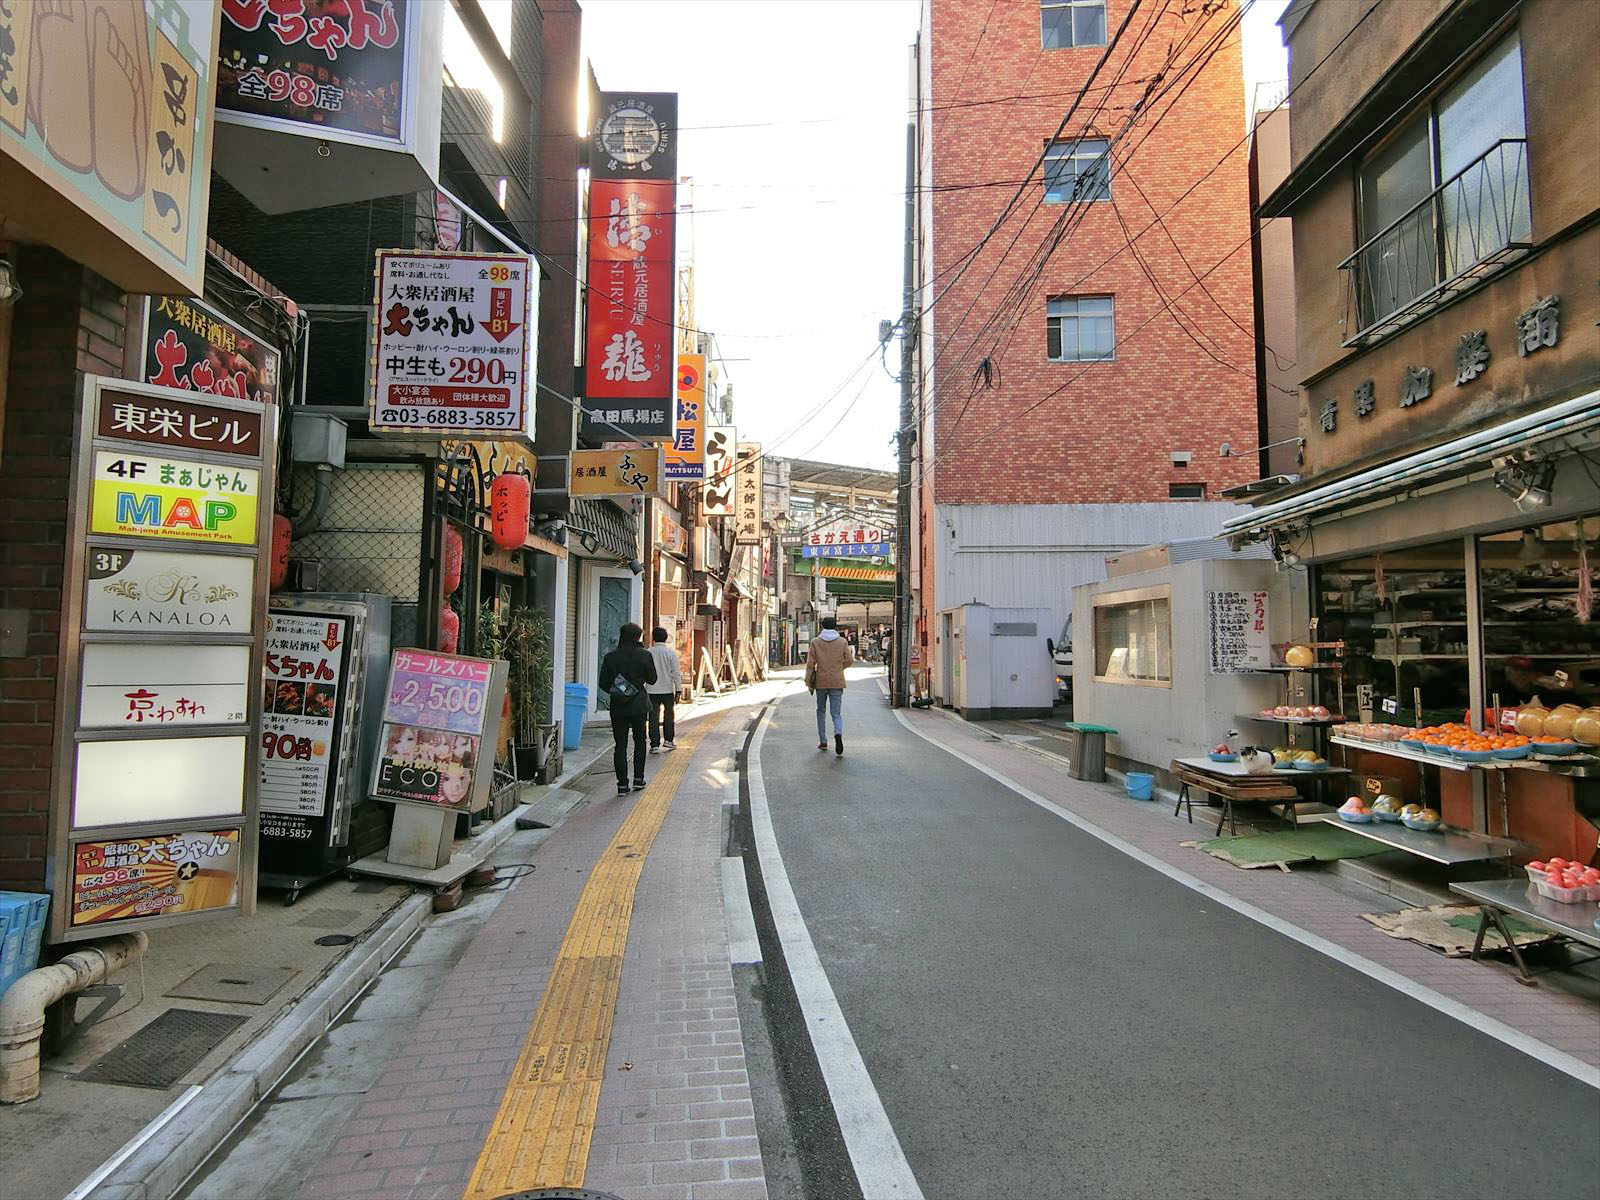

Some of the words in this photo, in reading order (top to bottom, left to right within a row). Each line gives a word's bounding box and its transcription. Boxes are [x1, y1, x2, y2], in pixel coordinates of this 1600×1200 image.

[238, 68, 343, 111] 全98席
[478, 266, 521, 282] 全98席
[387, 283, 475, 303] 大衆居酒屋
[631, 255, 649, 326] 蔵元居酒屋
[491, 319, 509, 333] B1
[392, 386, 431, 396] 大小宴会
[452, 392, 506, 403] 団体様大歓迎
[399, 396, 445, 406] 飲み放題あり
[110, 402, 252, 445] 東栄ビル
[399, 408, 516, 426] 03-6883-5857
[590, 409, 665, 424] 高田馬場店
[106, 459, 148, 479] 4F
[160, 463, 248, 493] まぁじゃん
[575, 467, 608, 478] 居酒屋
[115, 491, 237, 531] MAP
[118, 525, 159, 535] Mah-jong
[161, 529, 212, 539] Amusement
[214, 532, 232, 540] Park
[810, 529, 880, 545] さかえ通り
[810, 543, 881, 557] 東京富士大学
[96, 553, 123, 572] 3F
[112, 609, 232, 626] KANALOA
[396, 655, 489, 676] ガールズバー
[124, 688, 207, 723] 京わすれ
[382, 765, 438, 787] ECO
[104, 842, 140, 857] 昭和の
[142, 835, 231, 865] 大ちゃん
